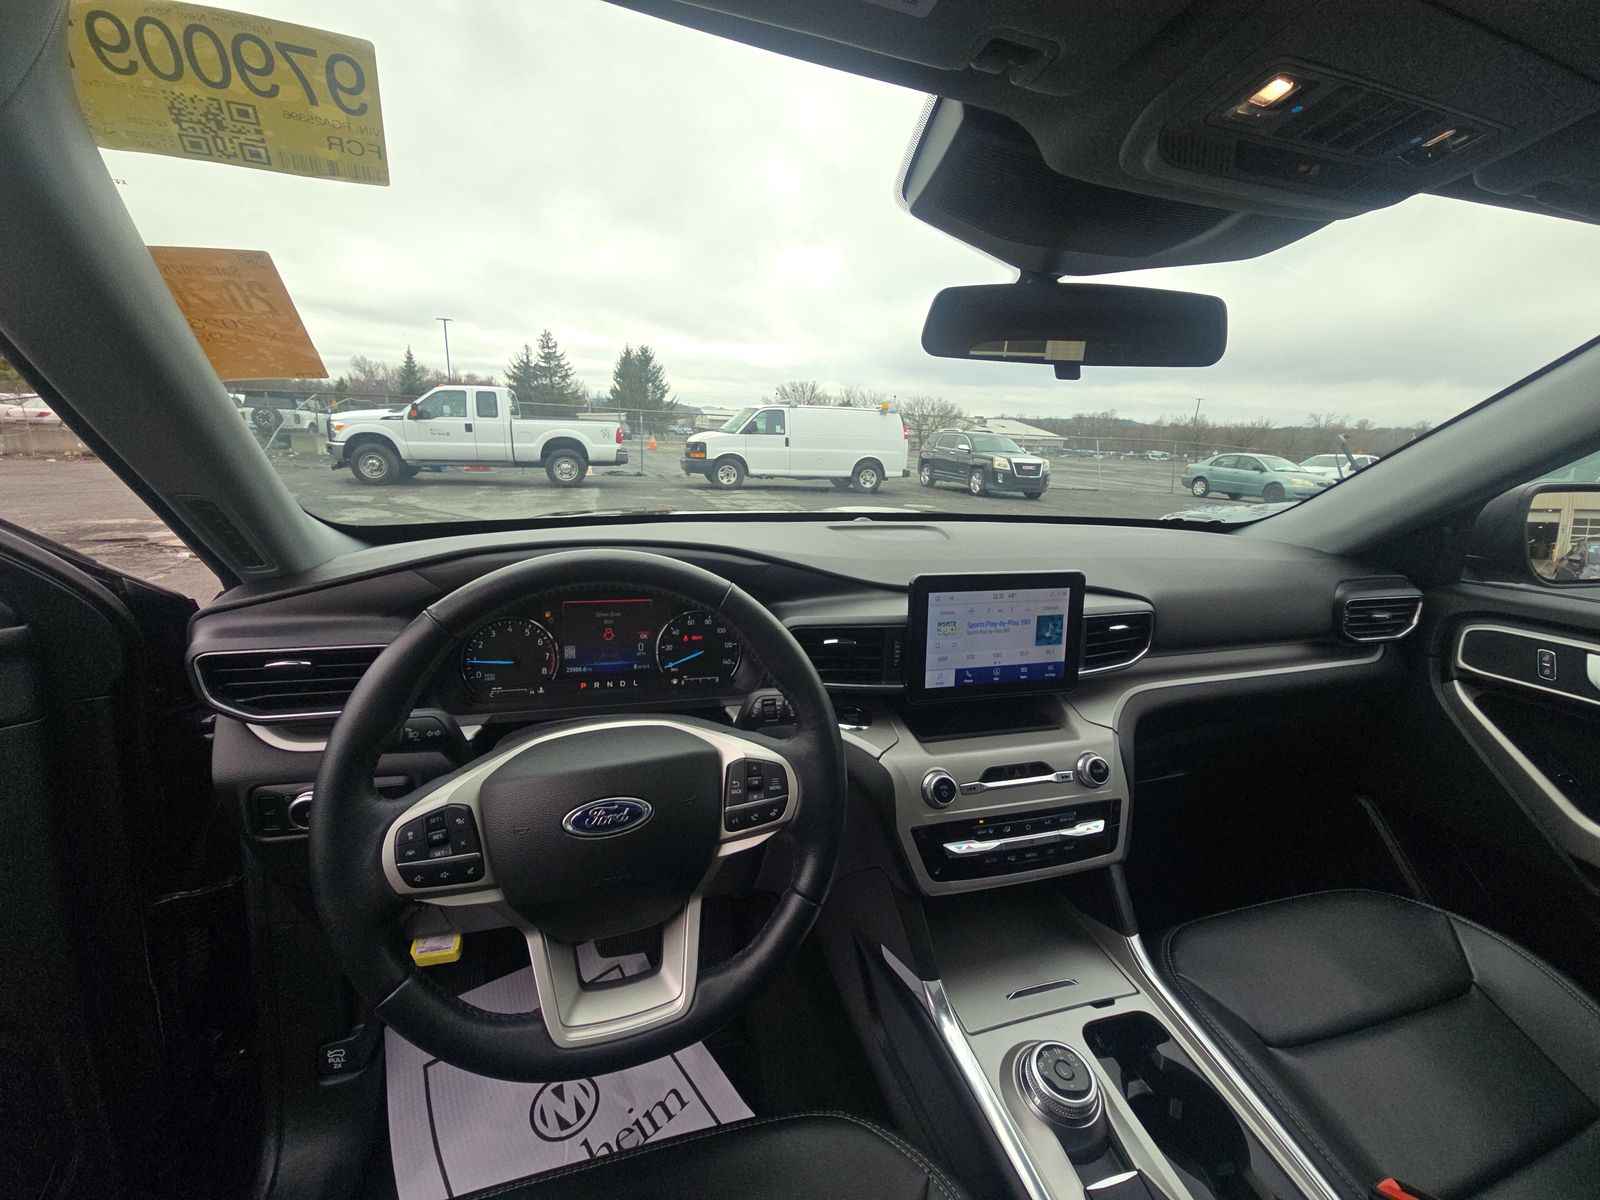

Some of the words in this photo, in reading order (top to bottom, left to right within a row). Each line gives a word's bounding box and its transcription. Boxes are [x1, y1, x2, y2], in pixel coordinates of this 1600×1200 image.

[507, 625, 513, 633] 4
[967, 621, 985, 630] Sports
[490, 630, 496, 638] 3
[524, 628, 530, 636] 5
[478, 640, 484, 649] 2
[537, 638, 543, 646] 6
[544, 652, 550, 660] 7
[476, 671, 482, 679] 0
[541, 667, 547, 675] 8
[594, 681, 600, 689] R
[633, 679, 638, 687] L
[584, 804, 630, 829] Ford
[432, 833, 444, 841] RES
[1042, 1050, 1050, 1058] R
[1053, 1047, 1062, 1055] N
[1067, 1053, 1075, 1061] D
